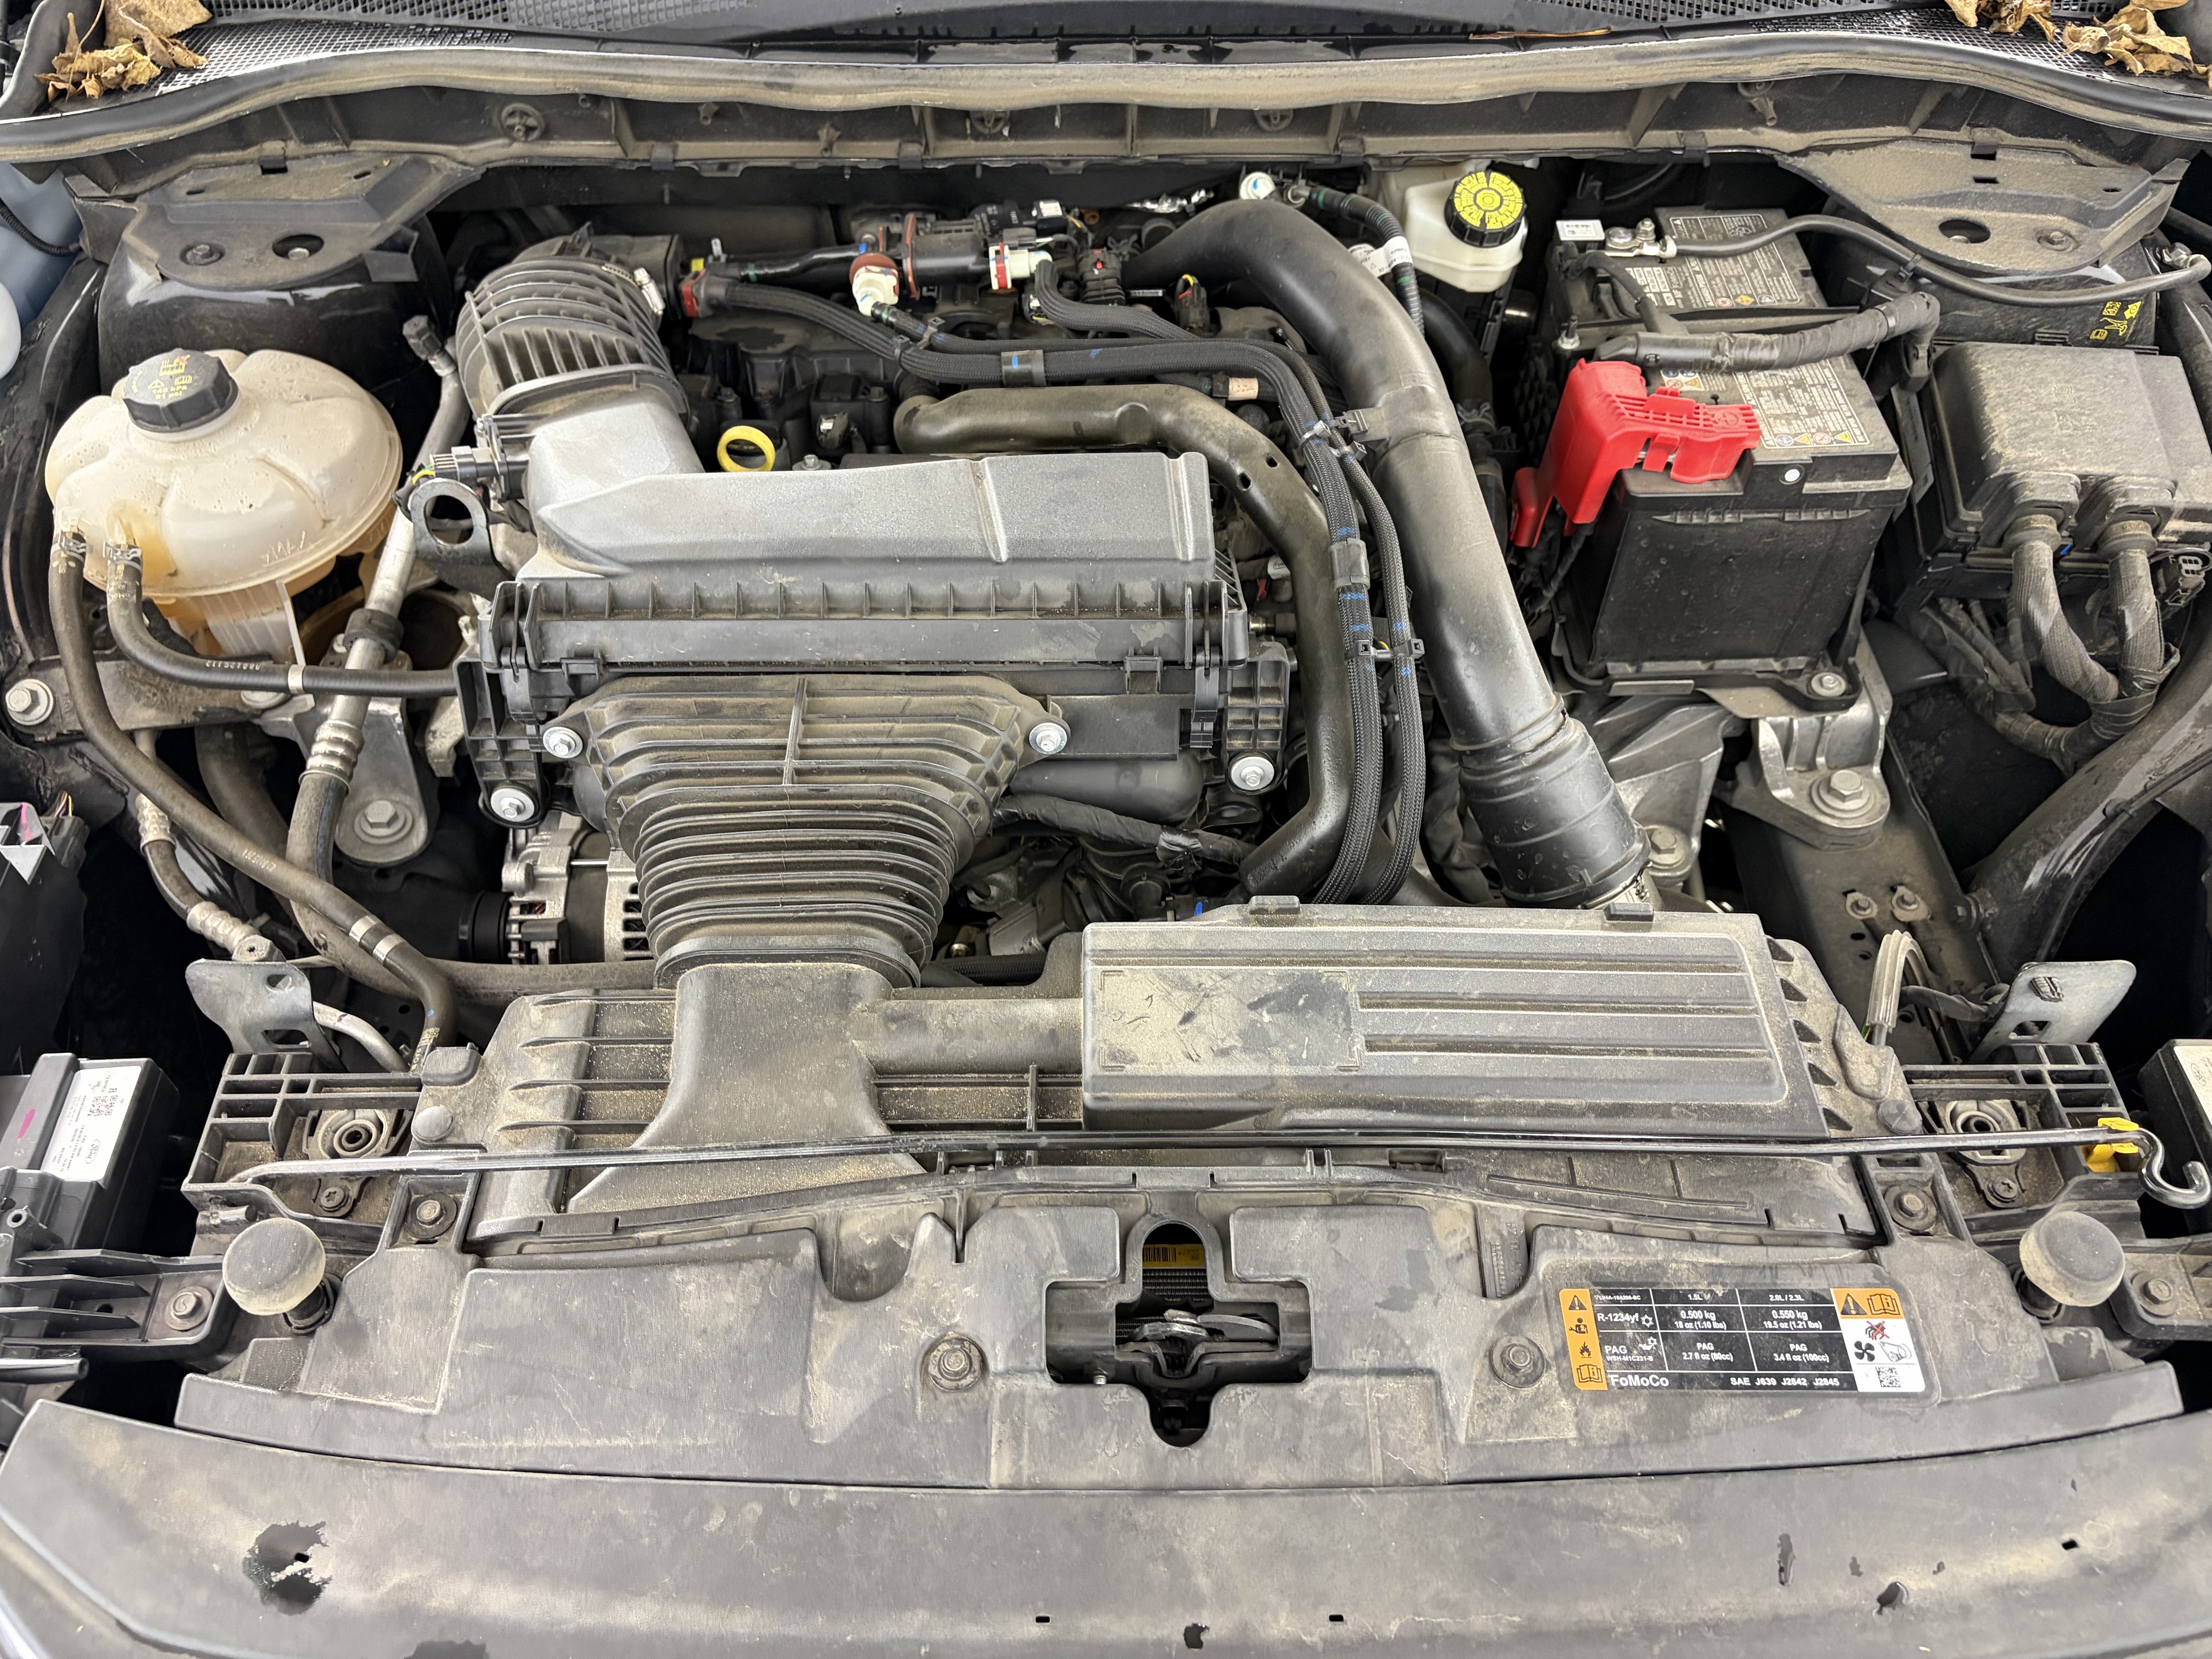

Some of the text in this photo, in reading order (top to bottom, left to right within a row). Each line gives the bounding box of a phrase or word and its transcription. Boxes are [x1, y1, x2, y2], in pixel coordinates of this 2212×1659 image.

[1597, 1313, 1639, 1323] R-1234yf
[1680, 1310, 1716, 1321] 0.500 kg
[1772, 1310, 1808, 1321] 0.550 kg
[1695, 1321, 1711, 1330] (1.10
[1712, 1321, 1727, 1330] lbs)
[1789, 1321, 1807, 1330] (1.21
[1808, 1321, 1822, 1330] lbs)
[1605, 1345, 1627, 1354] PAG
[1711, 1352, 1733, 1362] (80cc)
[1802, 1353, 1829, 1363] (100cc)
[1609, 1375, 1669, 1386] FoMoCo
[1781, 1377, 1808, 1386] J2842
[1813, 1377, 1839, 1386] J2845
